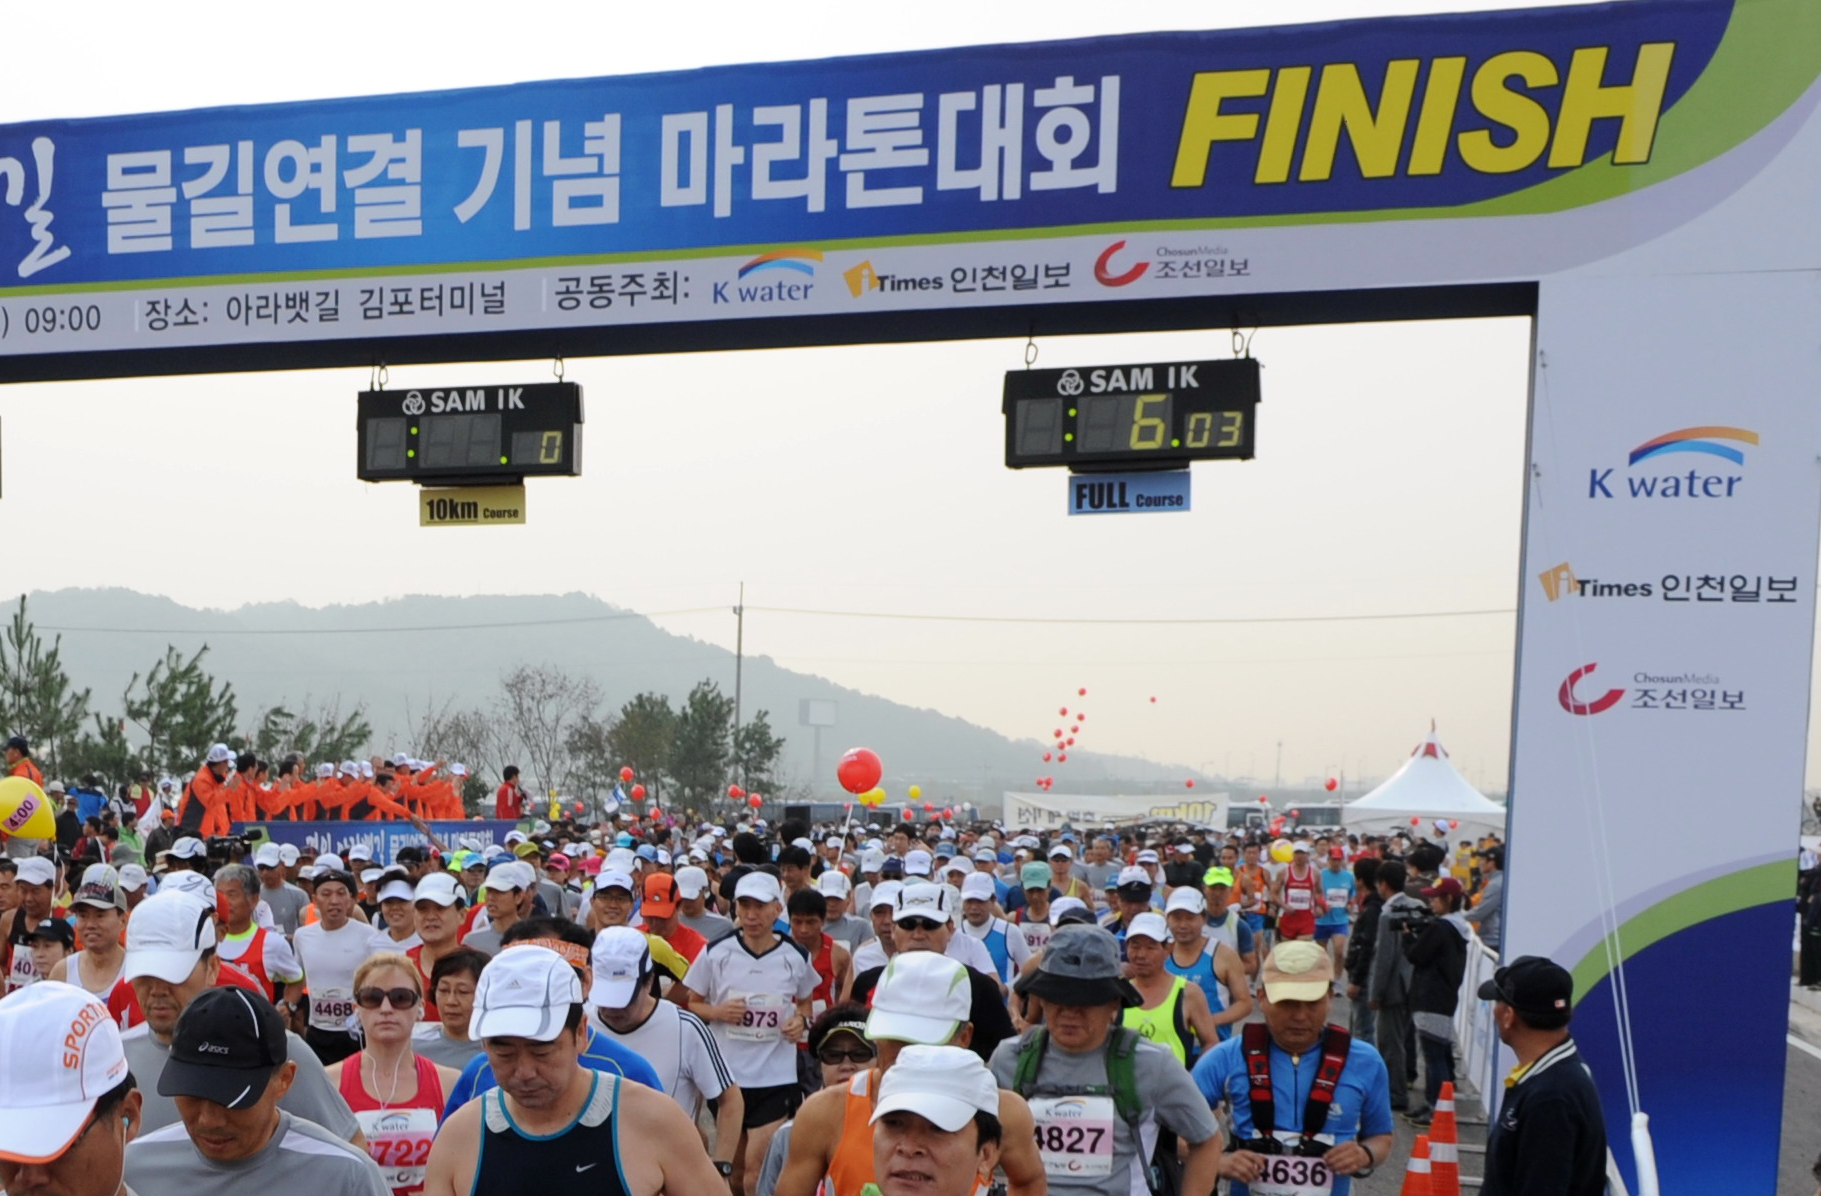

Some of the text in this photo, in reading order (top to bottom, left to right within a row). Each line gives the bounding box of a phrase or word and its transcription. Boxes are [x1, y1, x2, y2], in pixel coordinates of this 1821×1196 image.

[101, 128, 423, 254] 물길연결
[452, 113, 622, 231] 기념
[660, 74, 1121, 218] 마라톤대회
[1169, 40, 1676, 188] FINISH
[950, 262, 1072, 294] 인천일보
[1155, 256, 1251, 281] 조선일보
[554, 266, 690, 310] 공동주최:
[712, 276, 814, 304] K water
[24, 304, 102, 336] 09:00
[144, 280, 507, 333] 장소: 아라뱃길 김포터미널
[1090, 365, 1199, 393] SAM IK
[430, 387, 525, 413] SAM IK
[1075, 481, 1184, 510] FULL Course
[1588, 468, 1743, 498] K water
[426, 498, 519, 521] 10km Course
[1660, 574, 1798, 603] 인천일보
[1631, 688, 1747, 711] 조선일보
[8, 800, 34, 828] 4:00
[314, 1001, 354, 1017] 4468
[736, 1010, 778, 1028] 973
[208, 1043, 229, 1055] asics
[366, 1138, 433, 1167] 722
